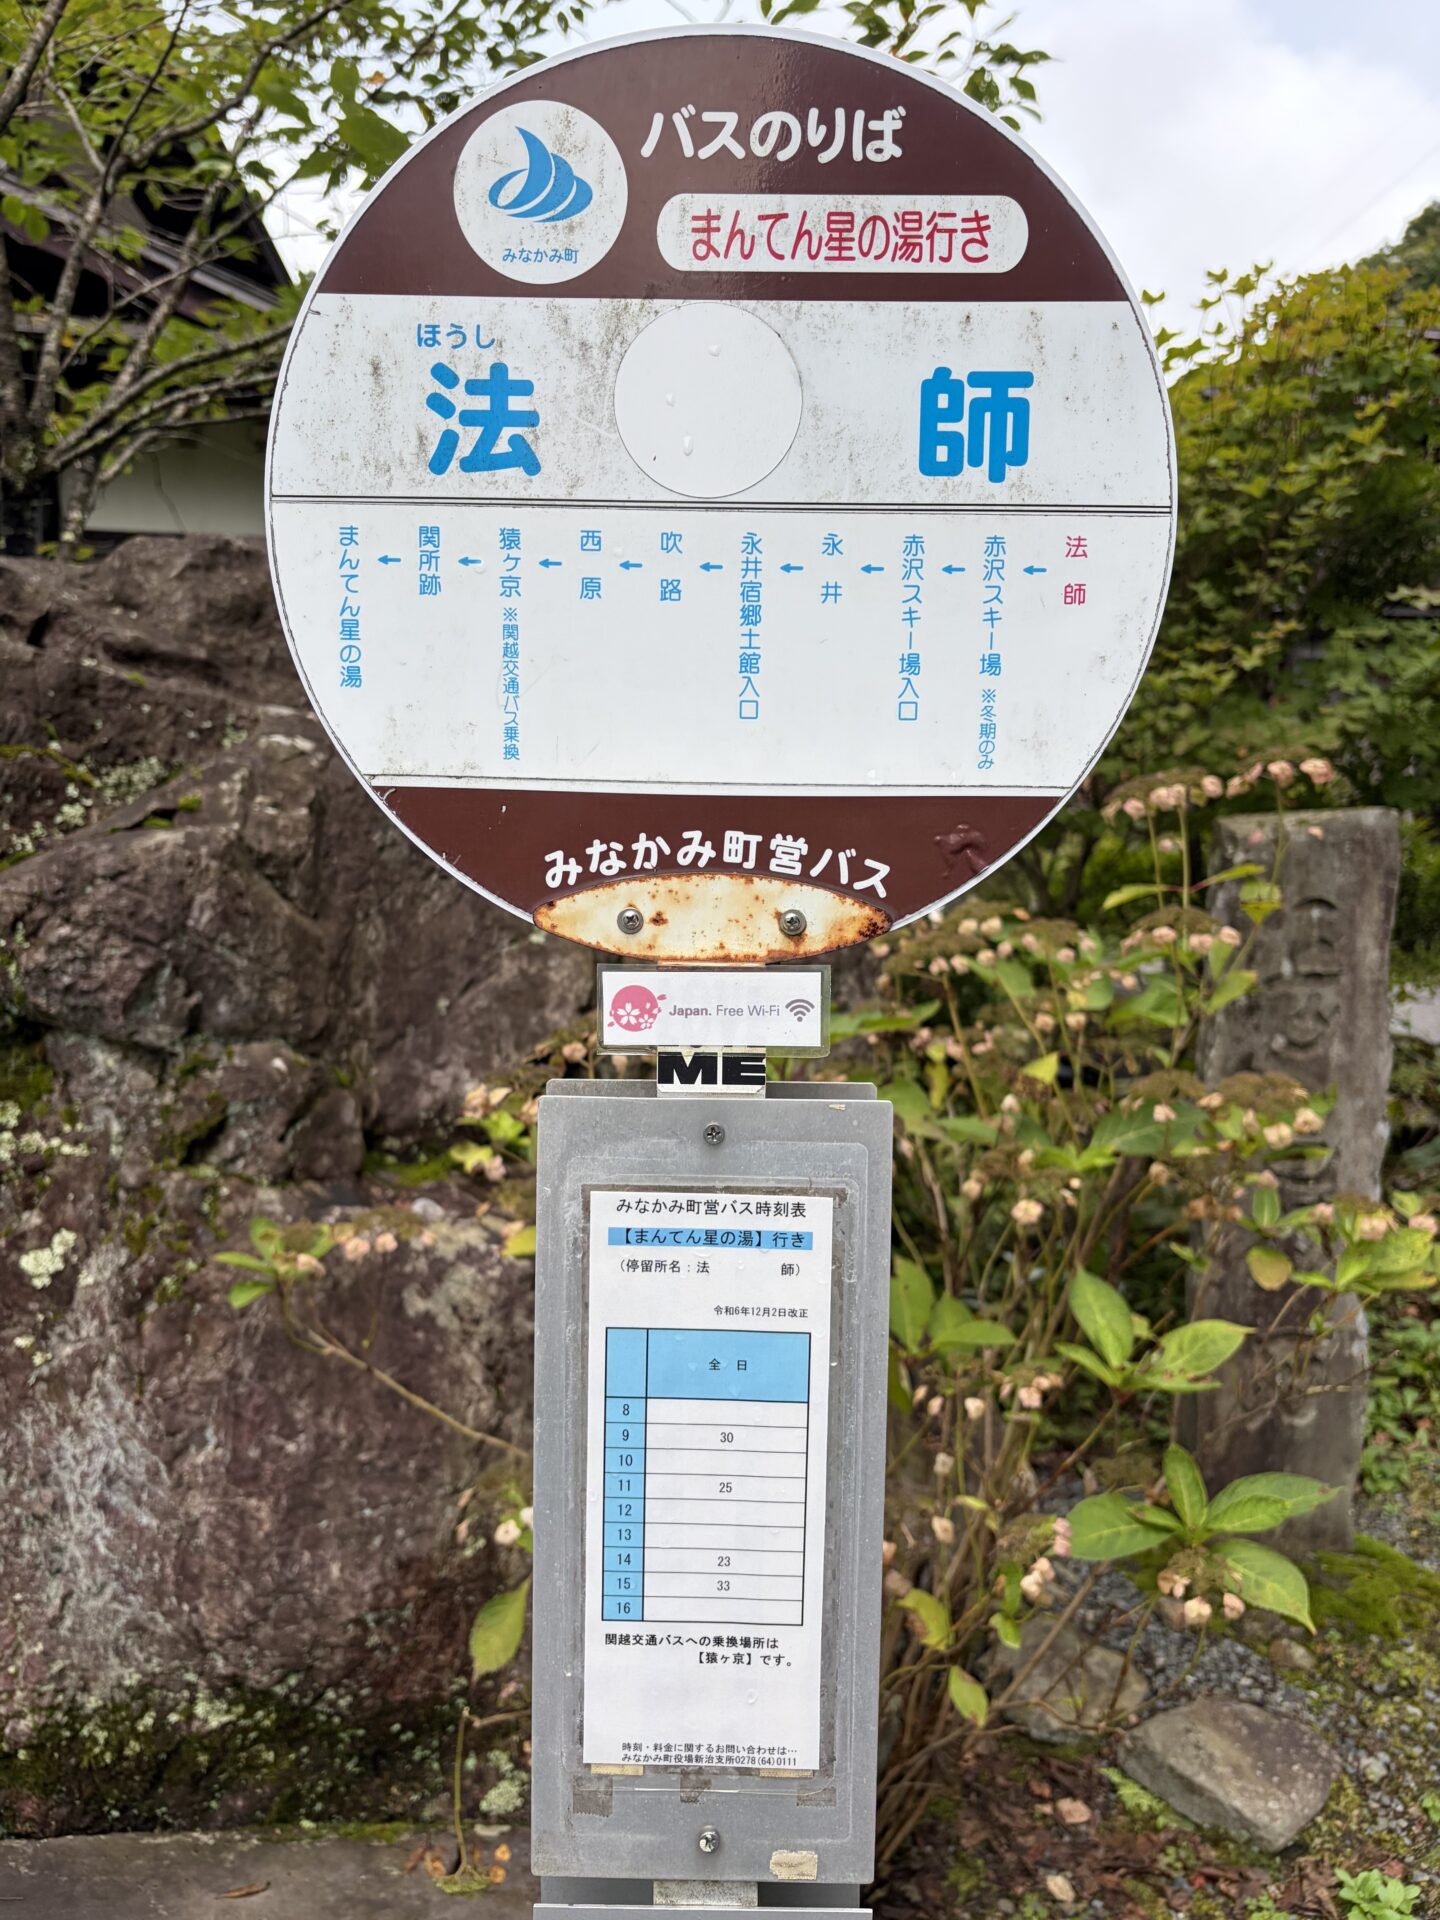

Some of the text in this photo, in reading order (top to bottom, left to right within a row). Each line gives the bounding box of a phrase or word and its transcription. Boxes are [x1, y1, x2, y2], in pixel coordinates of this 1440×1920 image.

[640, 104, 905, 163] バスのりば
[691, 209, 990, 264] まんてん星の湯行き
[502, 246, 580, 265] みなかみ町
[416, 323, 496, 349] ほうし
[426, 362, 1035, 484] 法 師
[418, 526, 442, 596] 関所跡
[338, 525, 363, 689] まんてん星の湯
[738, 532, 763, 720] 永井宿郷土館入口
[898, 534, 925, 721] 赤沢スキー場入口
[544, 830, 891, 899] みなかみ町営バス
[668, 1005, 781, 1019] Japan. Free Wi-Fi
[657, 1052, 766, 1085] ME
[616, 1198, 807, 1218] みなかみ町営バス時刻表
[713, 1305, 808, 1318] 令和6年12月2日改正
[622, 1404, 630, 1416] 8
[622, 1430, 734, 1443] 9 30
[618, 1455, 633, 1466] 10
[618, 1480, 733, 1493] 11 25
[617, 1504, 632, 1516] 12
[617, 1529, 632, 1541] 13
[617, 1553, 731, 1567] 14 23
[617, 1578, 730, 1591] 15 33
[616, 1602, 631, 1614] 16
[605, 1633, 779, 1649] 関越交通バスへの乗換場所は
